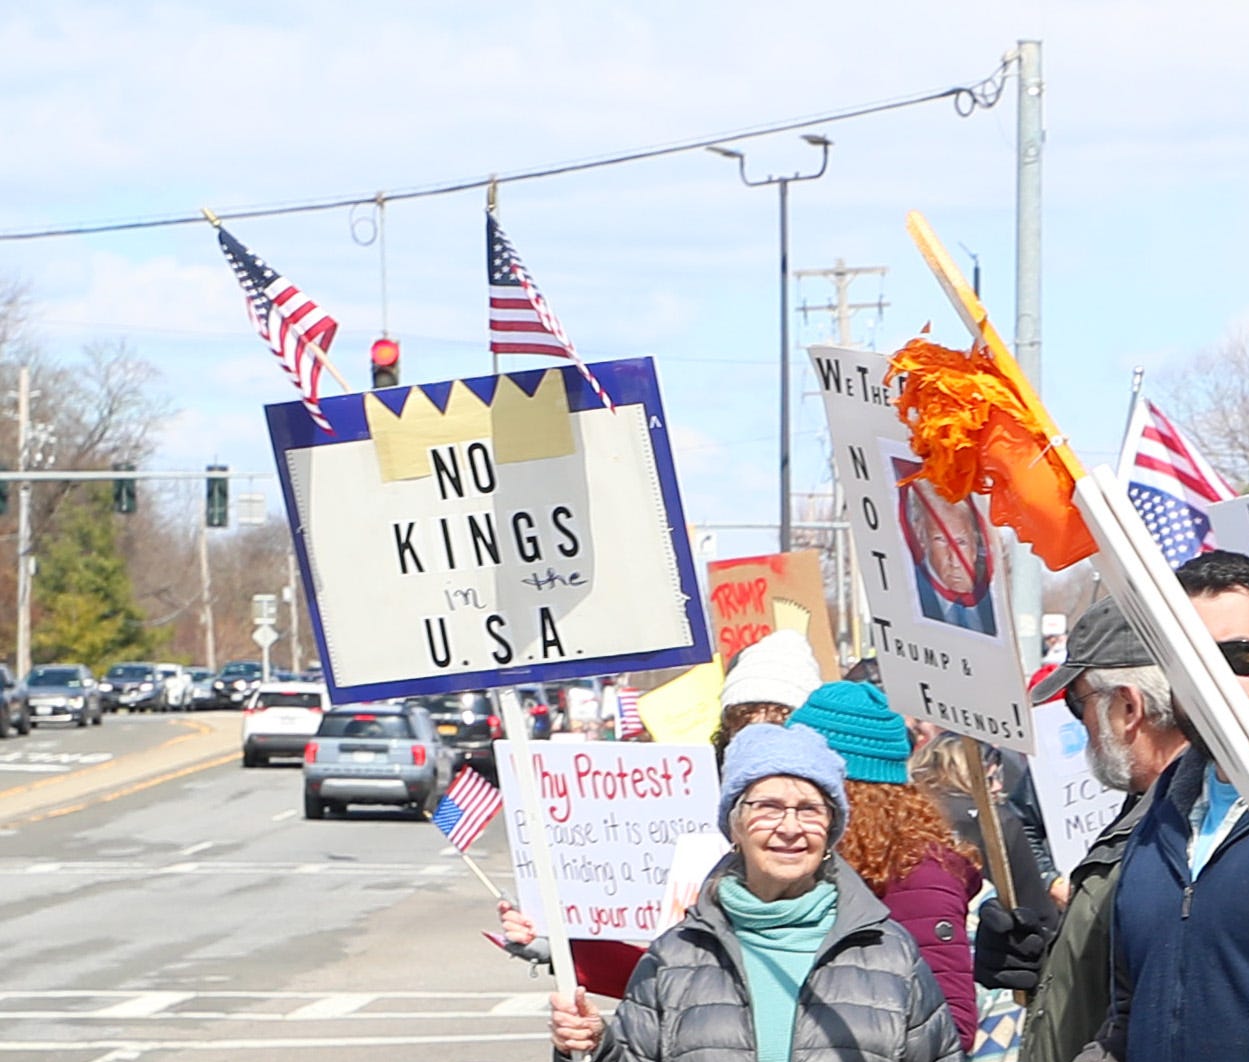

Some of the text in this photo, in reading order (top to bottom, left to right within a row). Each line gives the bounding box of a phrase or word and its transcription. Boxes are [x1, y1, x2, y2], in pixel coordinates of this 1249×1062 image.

[431, 441, 496, 501] NO
[394, 505, 581, 574] KINGS
[444, 570, 588, 611] in the
[873, 617, 951, 670] TRUMP
[920, 682, 1025, 740] FRIENDS!
[574, 753, 693, 800] Protest?
[603, 812, 619, 842] it
[625, 820, 642, 845] is
[560, 853, 618, 896] hiding
[620, 862, 635, 883] a
[588, 905, 630, 935] your
